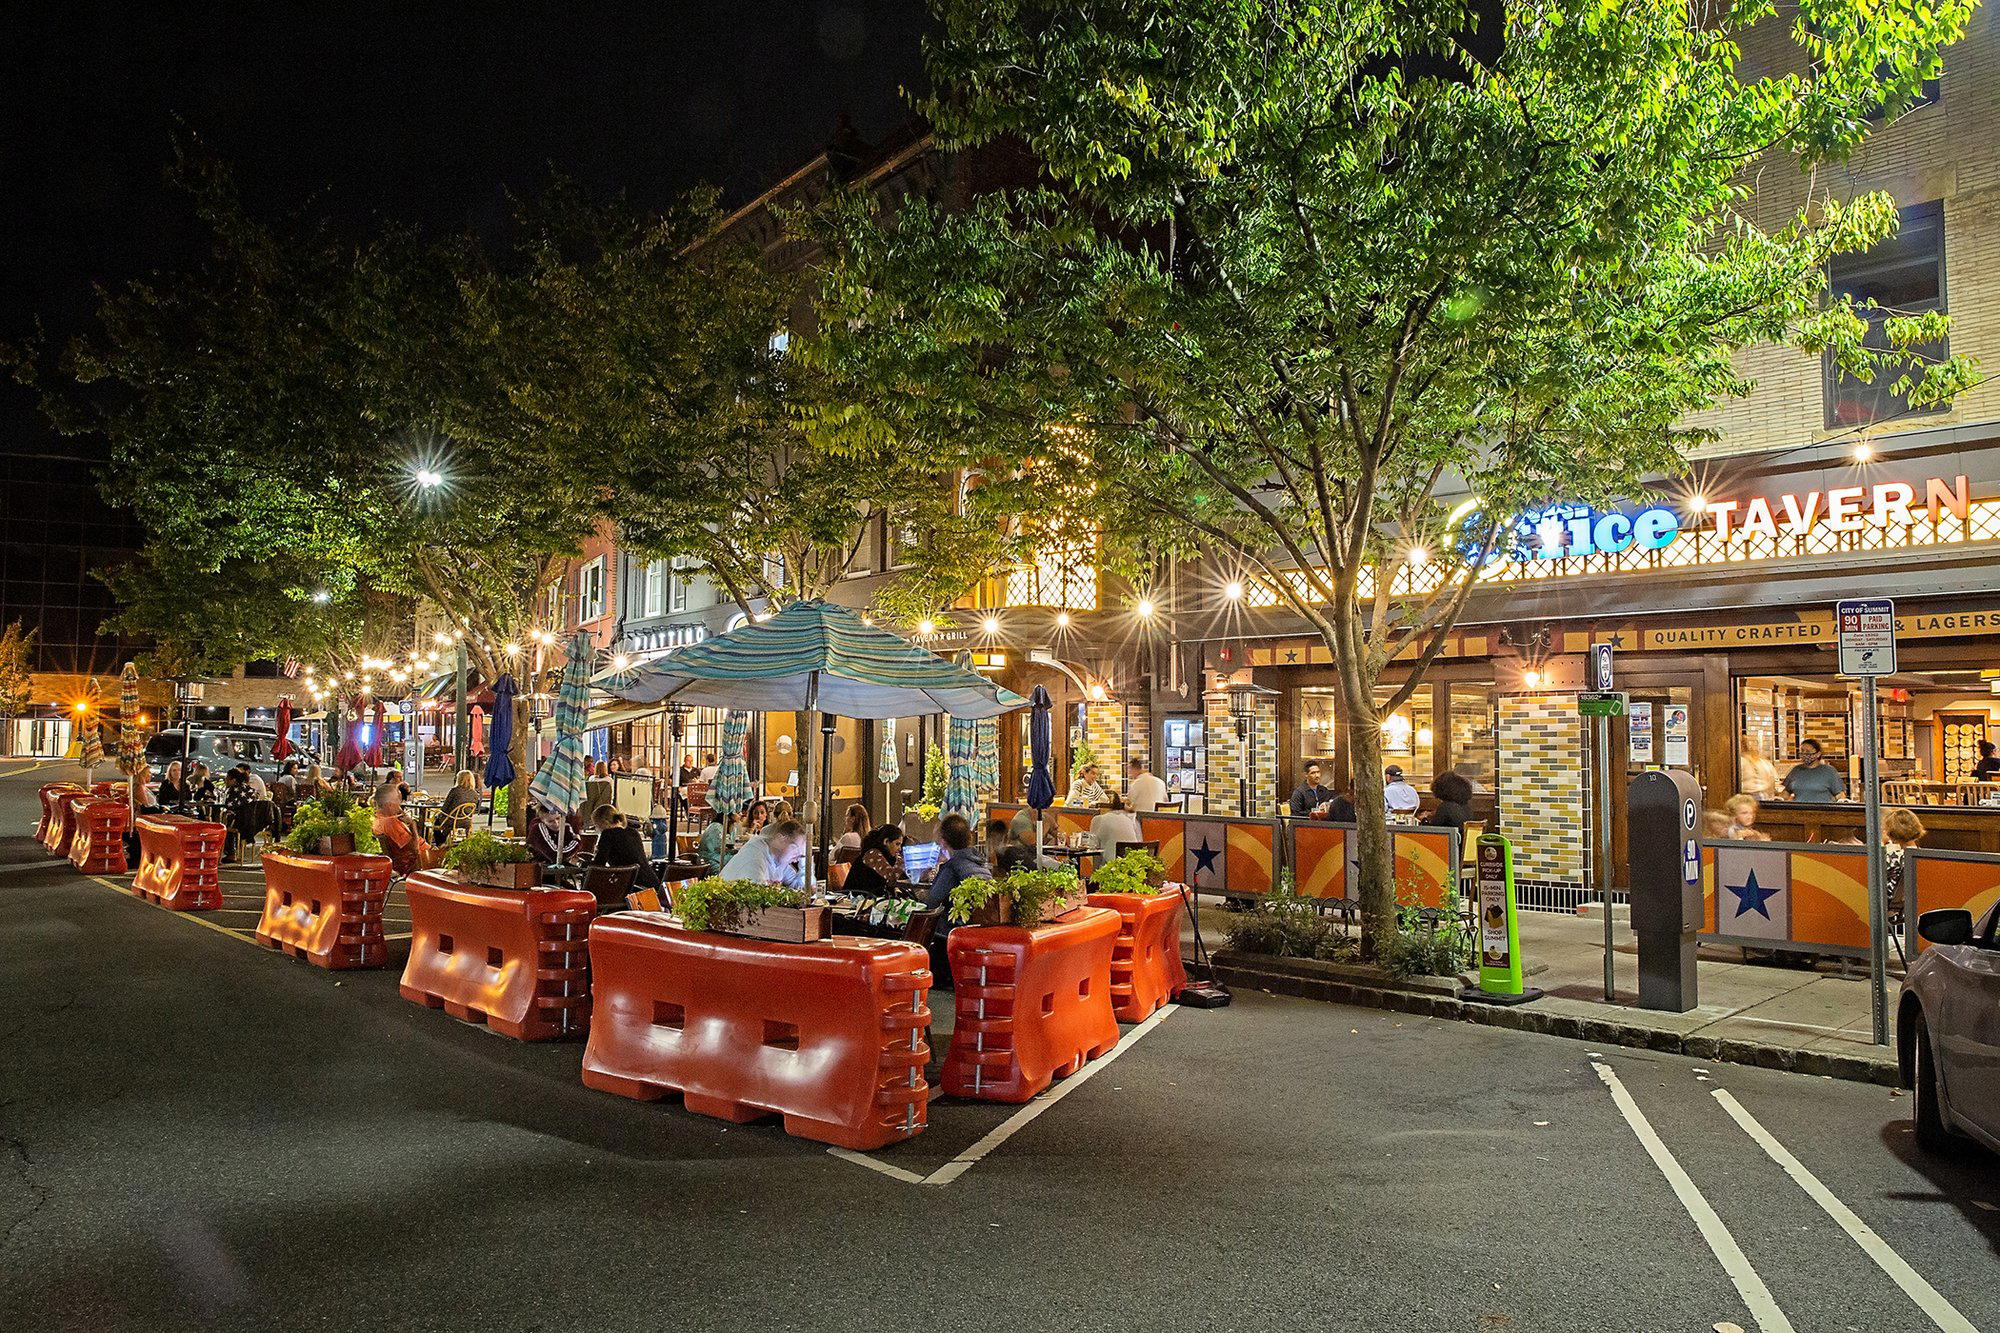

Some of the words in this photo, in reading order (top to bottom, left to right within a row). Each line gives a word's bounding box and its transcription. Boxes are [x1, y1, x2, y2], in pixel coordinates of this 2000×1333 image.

[1706, 475, 1971, 543] TAVERN
[1844, 615, 1858, 625] 90
[1868, 615, 1883, 623] PAID
[1655, 629, 1727, 644] QUALITY
[1737, 624, 1821, 640] CRAFTED
[1917, 613, 2000, 630] LAGERS
[912, 633, 939, 644] TAVERN
[946, 631, 968, 641] GRILL
[1686, 803, 1694, 825] P
